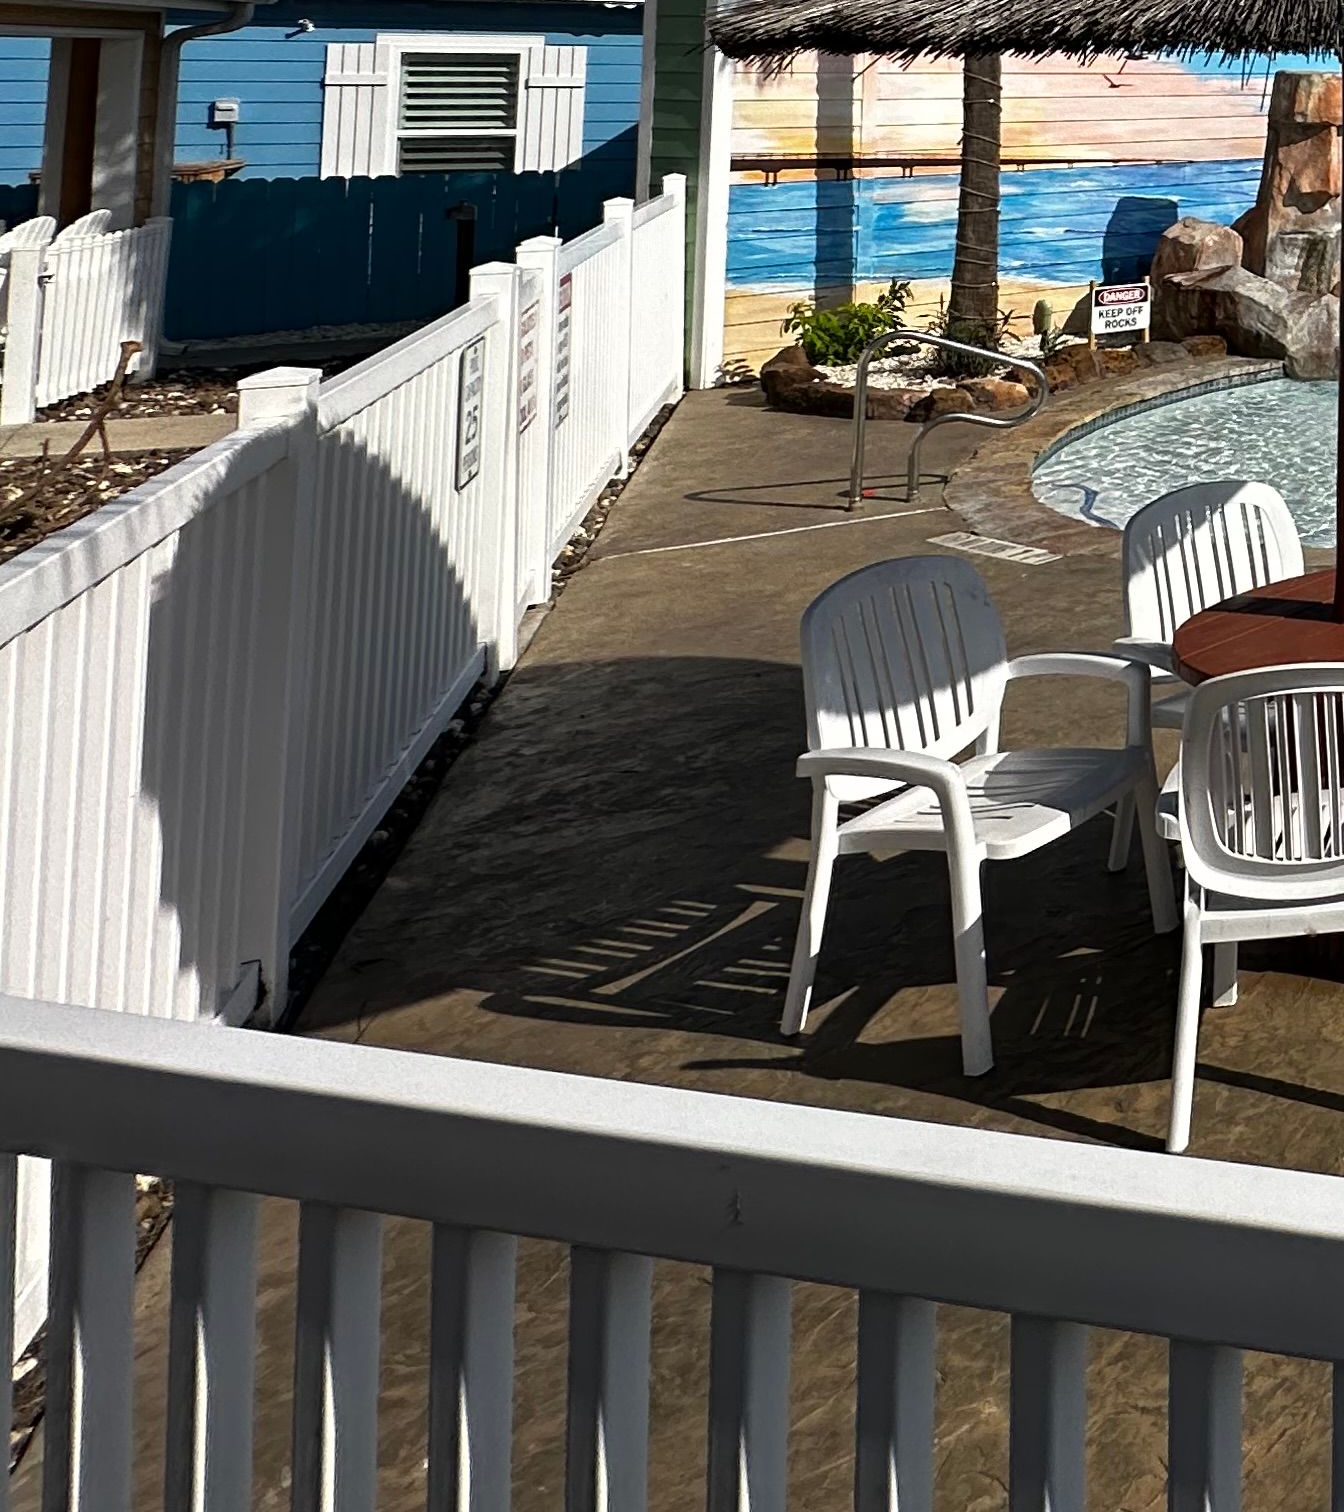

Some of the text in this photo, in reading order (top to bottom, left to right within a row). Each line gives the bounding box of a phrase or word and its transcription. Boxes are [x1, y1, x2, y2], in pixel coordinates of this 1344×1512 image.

[1103, 289, 1140, 302] DANGER
[1098, 305, 1143, 319] KEEP OFF
[1104, 317, 1137, 329] ROCKS
[465, 404, 479, 446] 25
